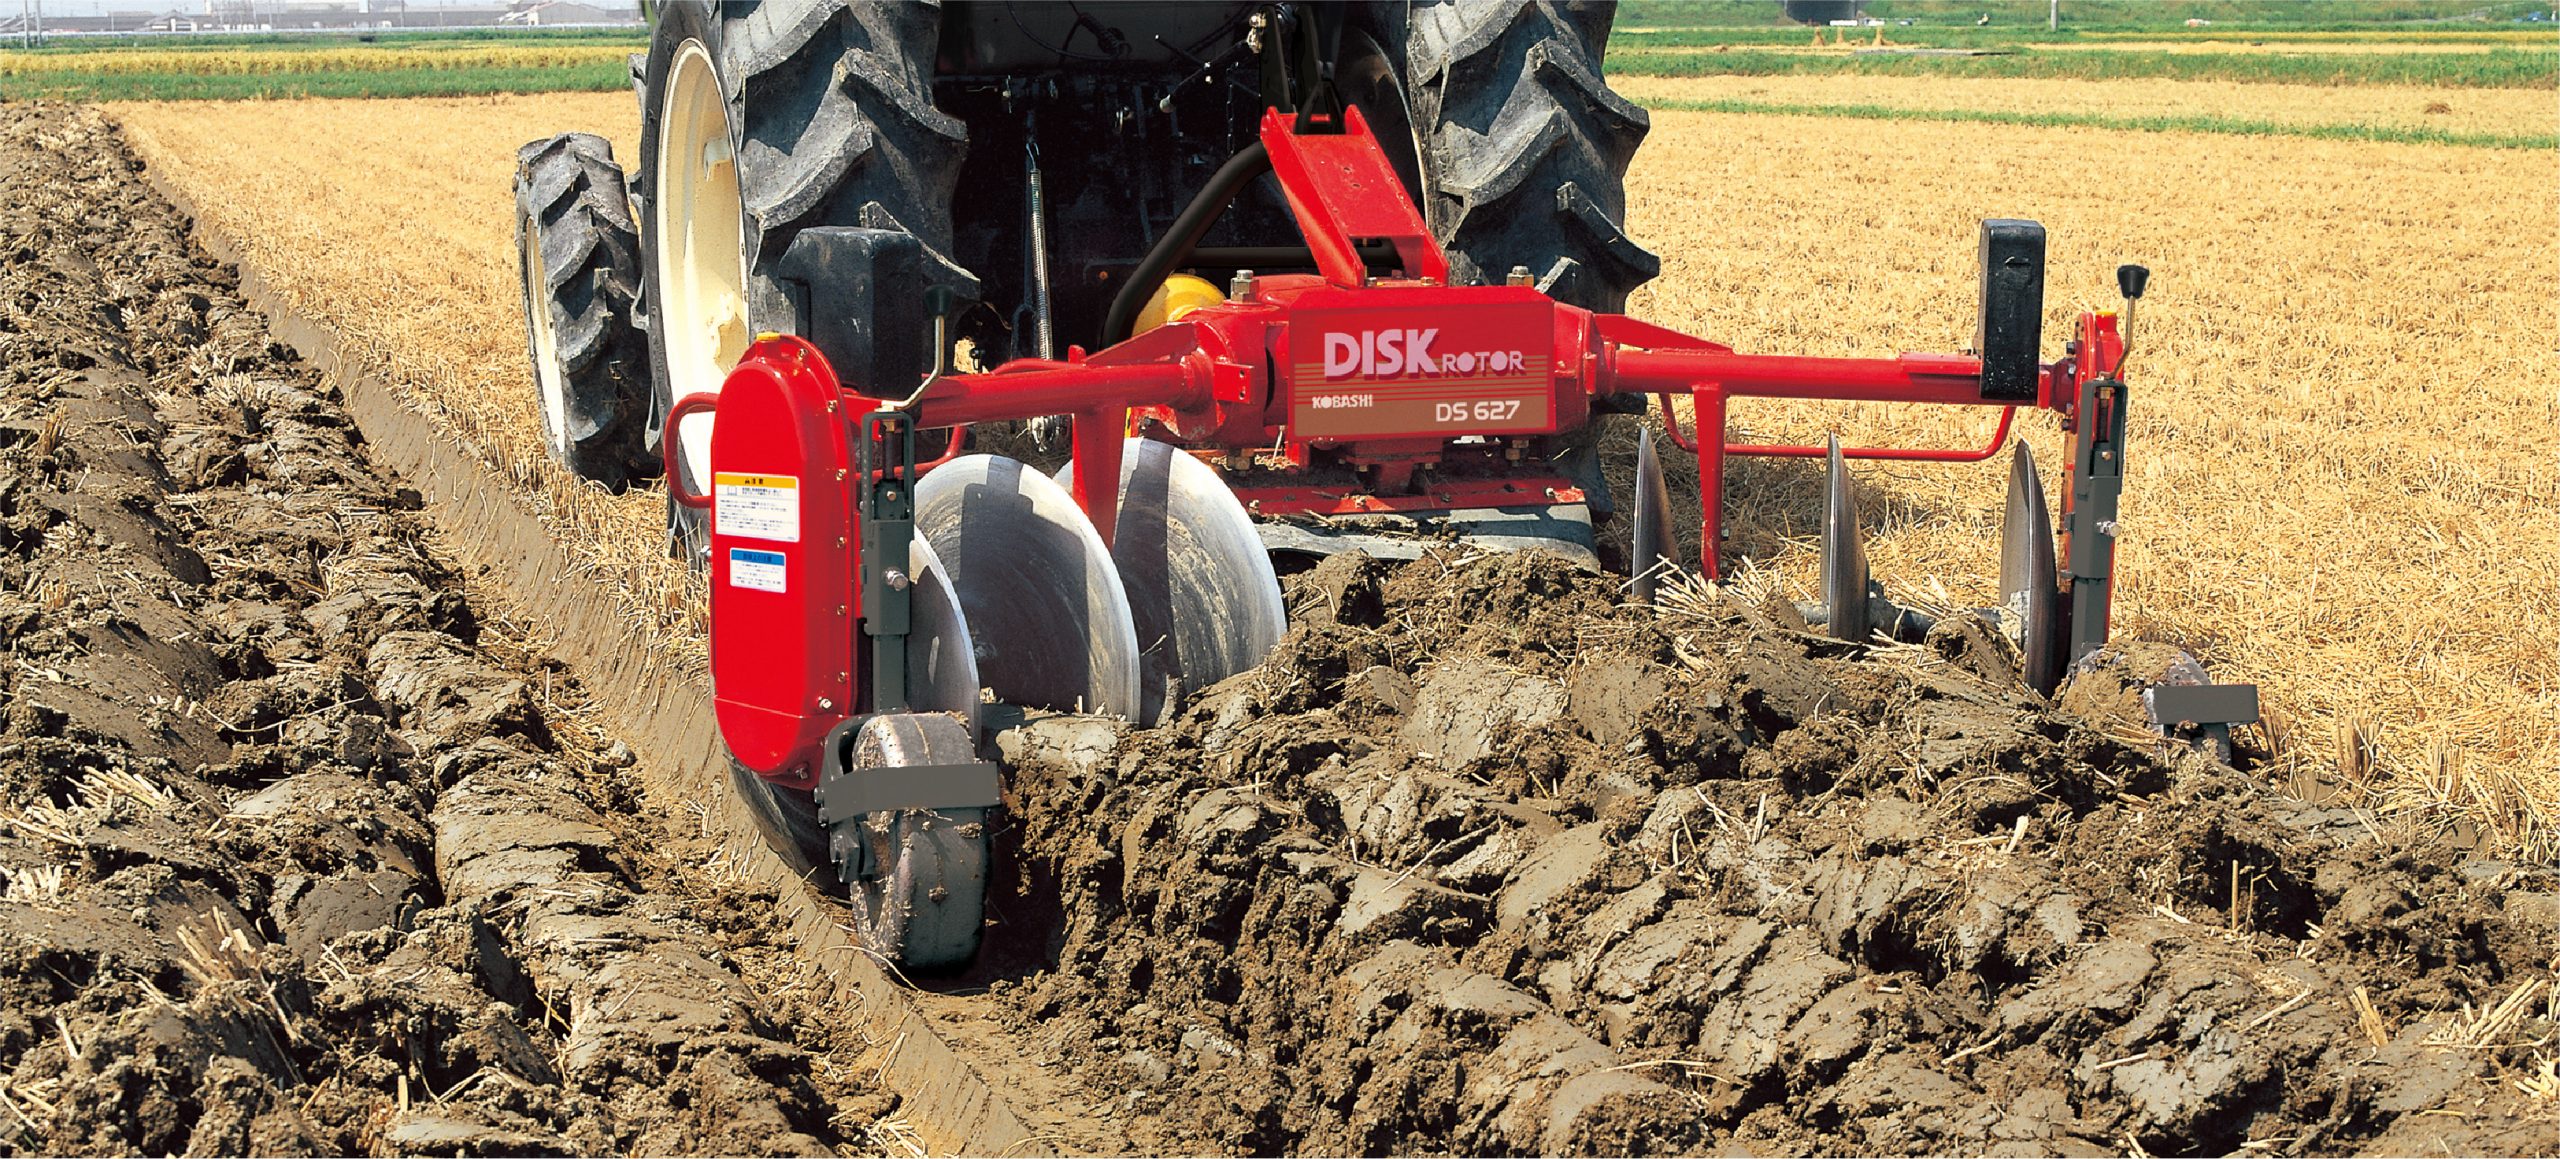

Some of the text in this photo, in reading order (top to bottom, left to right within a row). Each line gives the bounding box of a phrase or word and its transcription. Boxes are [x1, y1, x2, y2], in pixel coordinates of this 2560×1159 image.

[1324, 328, 1525, 378] DISK ROTOR
[1311, 394, 1373, 409] KOBASHI
[1435, 400, 1521, 422] DS 627
